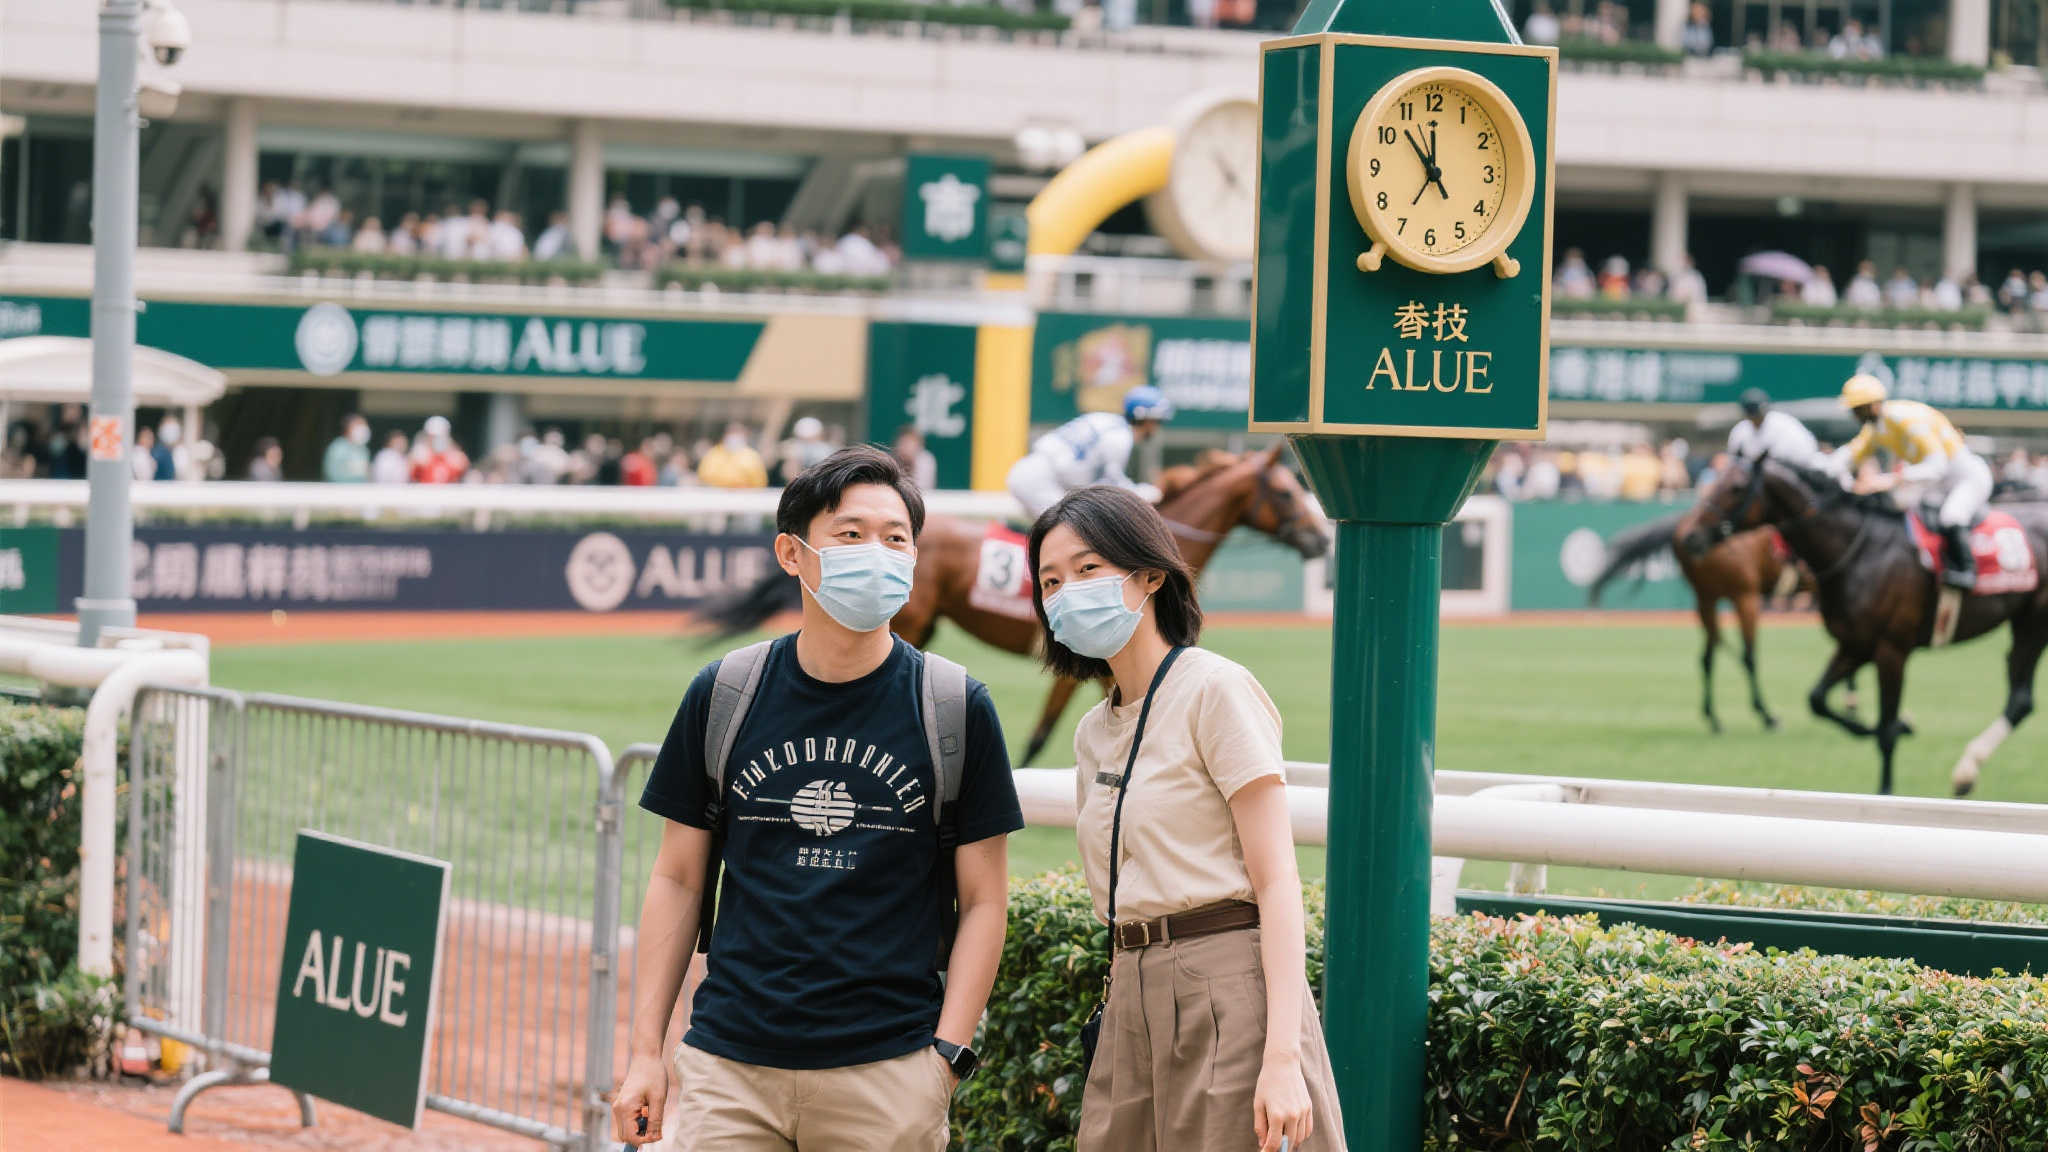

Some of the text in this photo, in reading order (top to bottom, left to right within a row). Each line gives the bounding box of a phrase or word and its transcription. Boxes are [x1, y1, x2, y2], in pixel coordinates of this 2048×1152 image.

[1400, 102, 1413, 121] 11
[1425, 93, 1444, 113] 12
[1459, 106, 1466, 124] 1
[1377, 125, 1397, 145] 10
[1477, 132, 1489, 150] 2
[1370, 158, 1381, 178] 9
[1483, 165, 1495, 184] 3
[1376, 191, 1388, 210] 8
[1472, 199, 1486, 217] 4
[1397, 217, 1408, 236] 7
[1454, 221, 1466, 240] 5
[1424, 228, 1436, 247] 6
[512, 316, 648, 374] ALUE
[1365, 347, 1494, 394] ALUE
[292, 929, 412, 1028] ALUE
